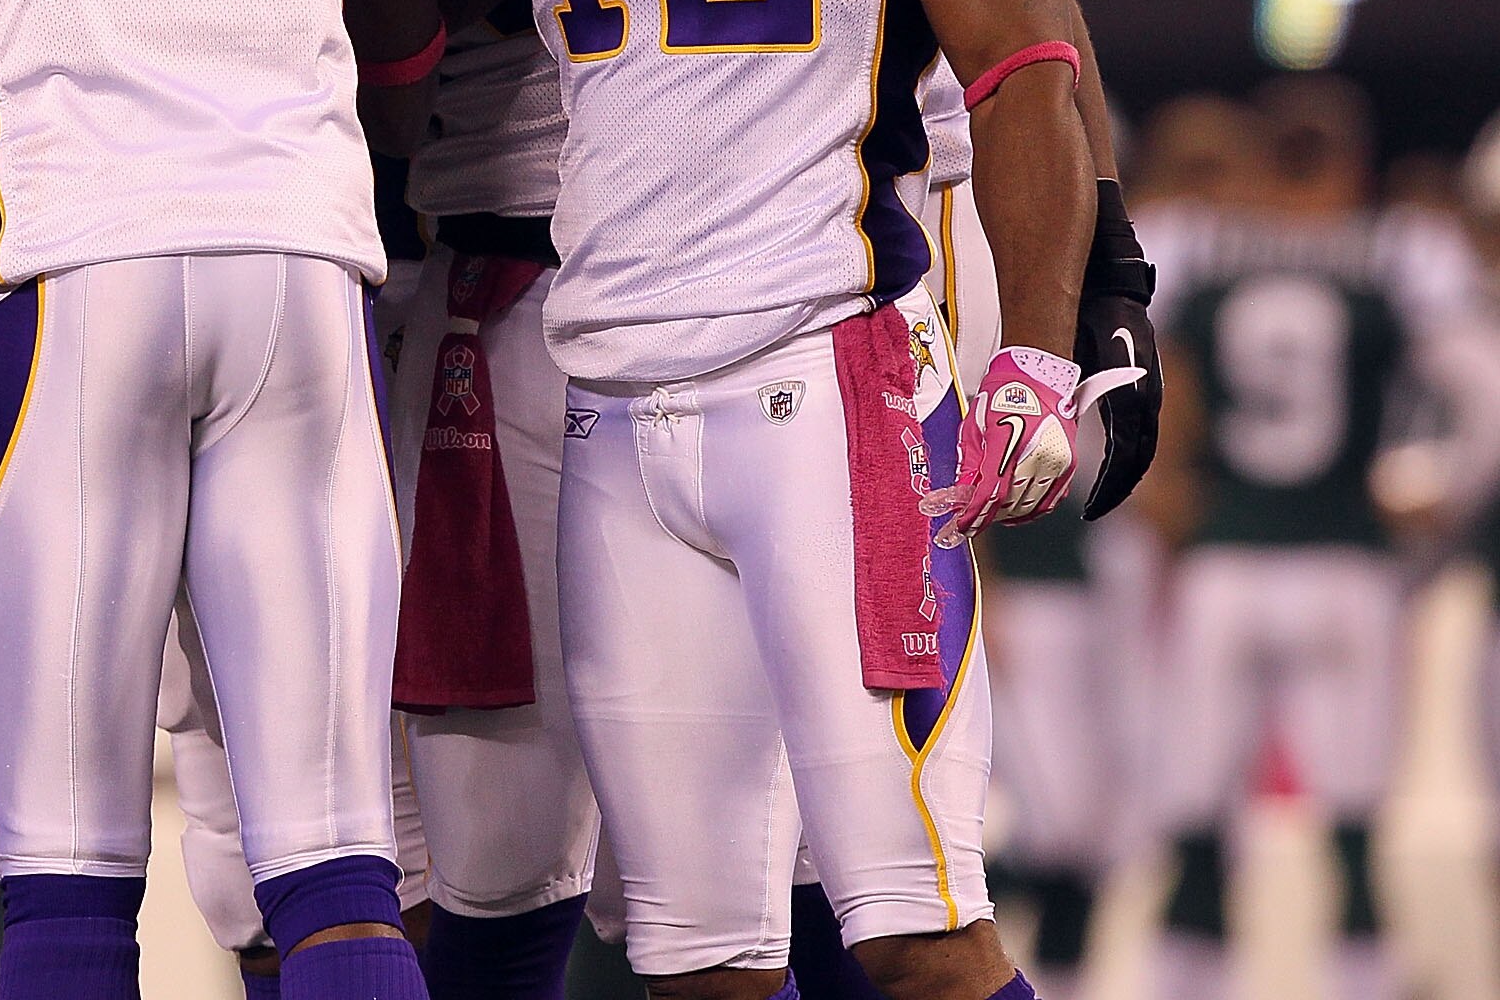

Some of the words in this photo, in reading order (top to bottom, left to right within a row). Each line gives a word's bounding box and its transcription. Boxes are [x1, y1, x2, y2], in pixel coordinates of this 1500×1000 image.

[445, 377, 470, 395] NFL
[1212, 273, 1353, 488] 9
[771, 401, 792, 416] NFL
[425, 425, 492, 450] Wilson
